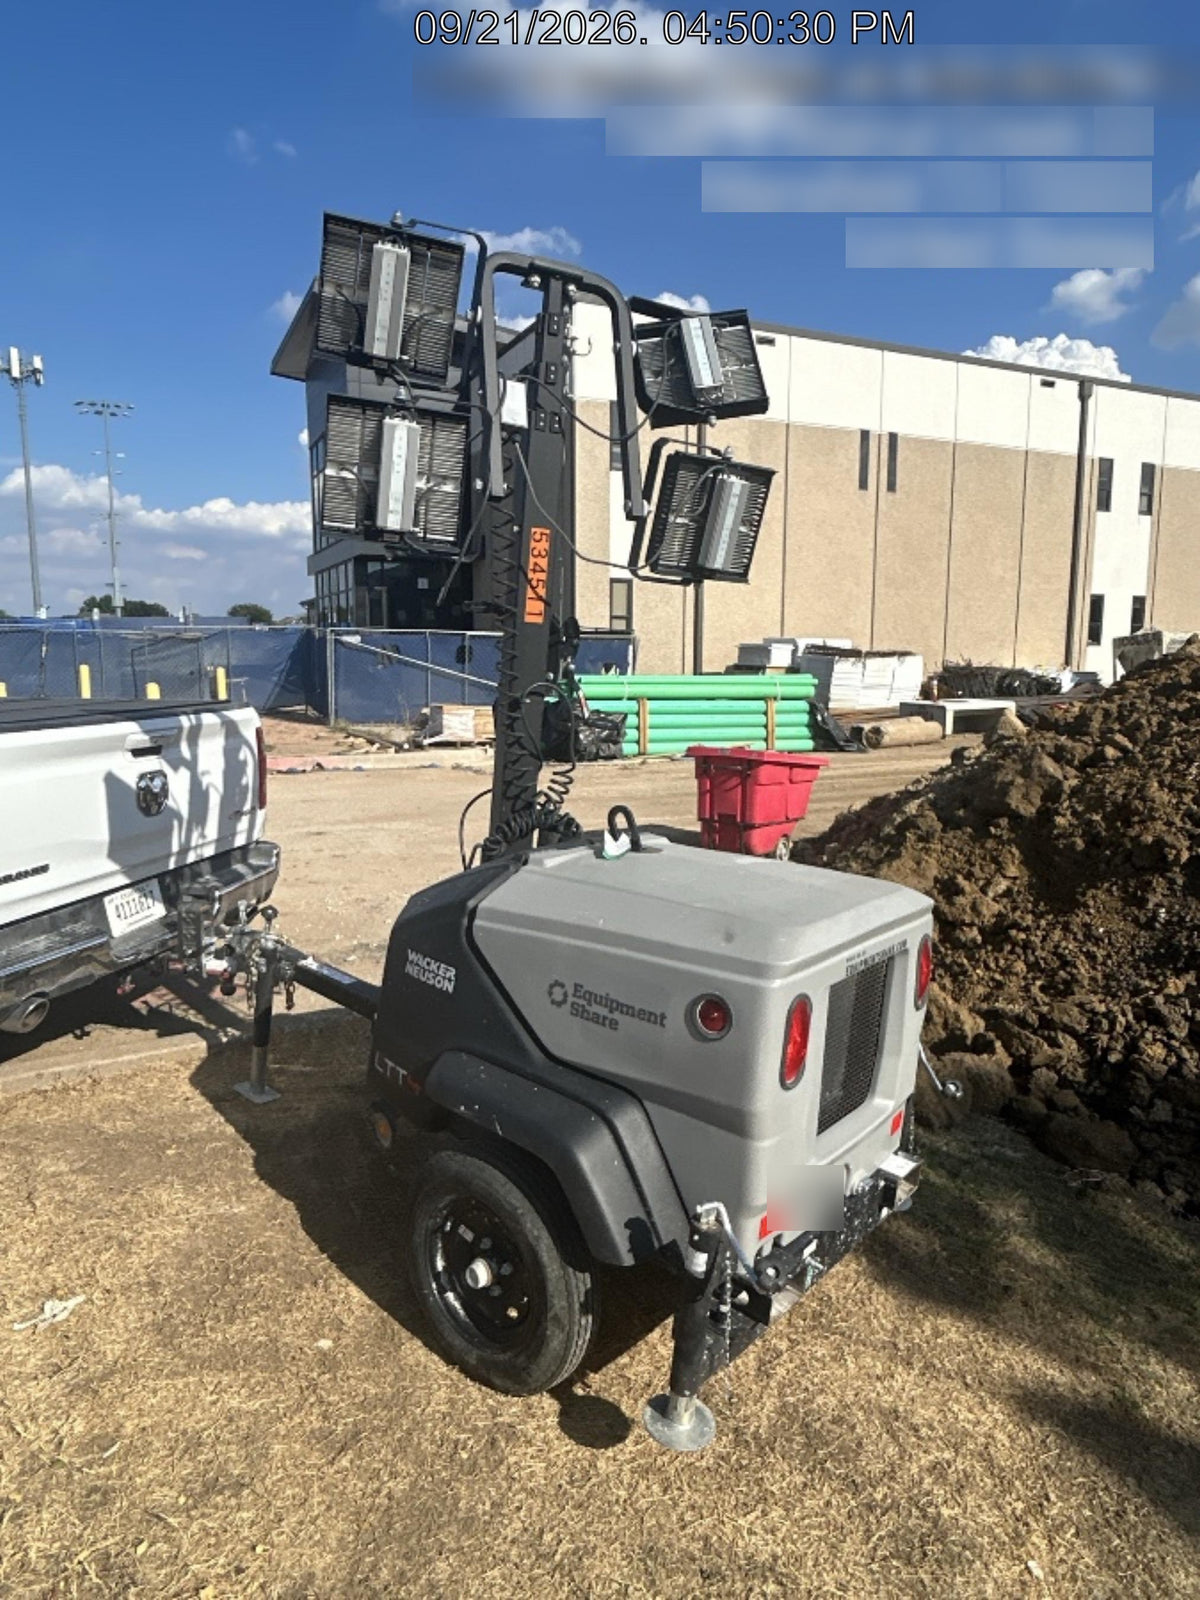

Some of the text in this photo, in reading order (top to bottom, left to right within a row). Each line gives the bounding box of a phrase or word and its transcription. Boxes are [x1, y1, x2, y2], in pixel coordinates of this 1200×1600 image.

[527, 530, 549, 616] 534511
[404, 961, 455, 994] NEUSON
[408, 949, 456, 980] WACKER
[570, 1001, 619, 1031] Share
[572, 982, 667, 1028] Equipment
